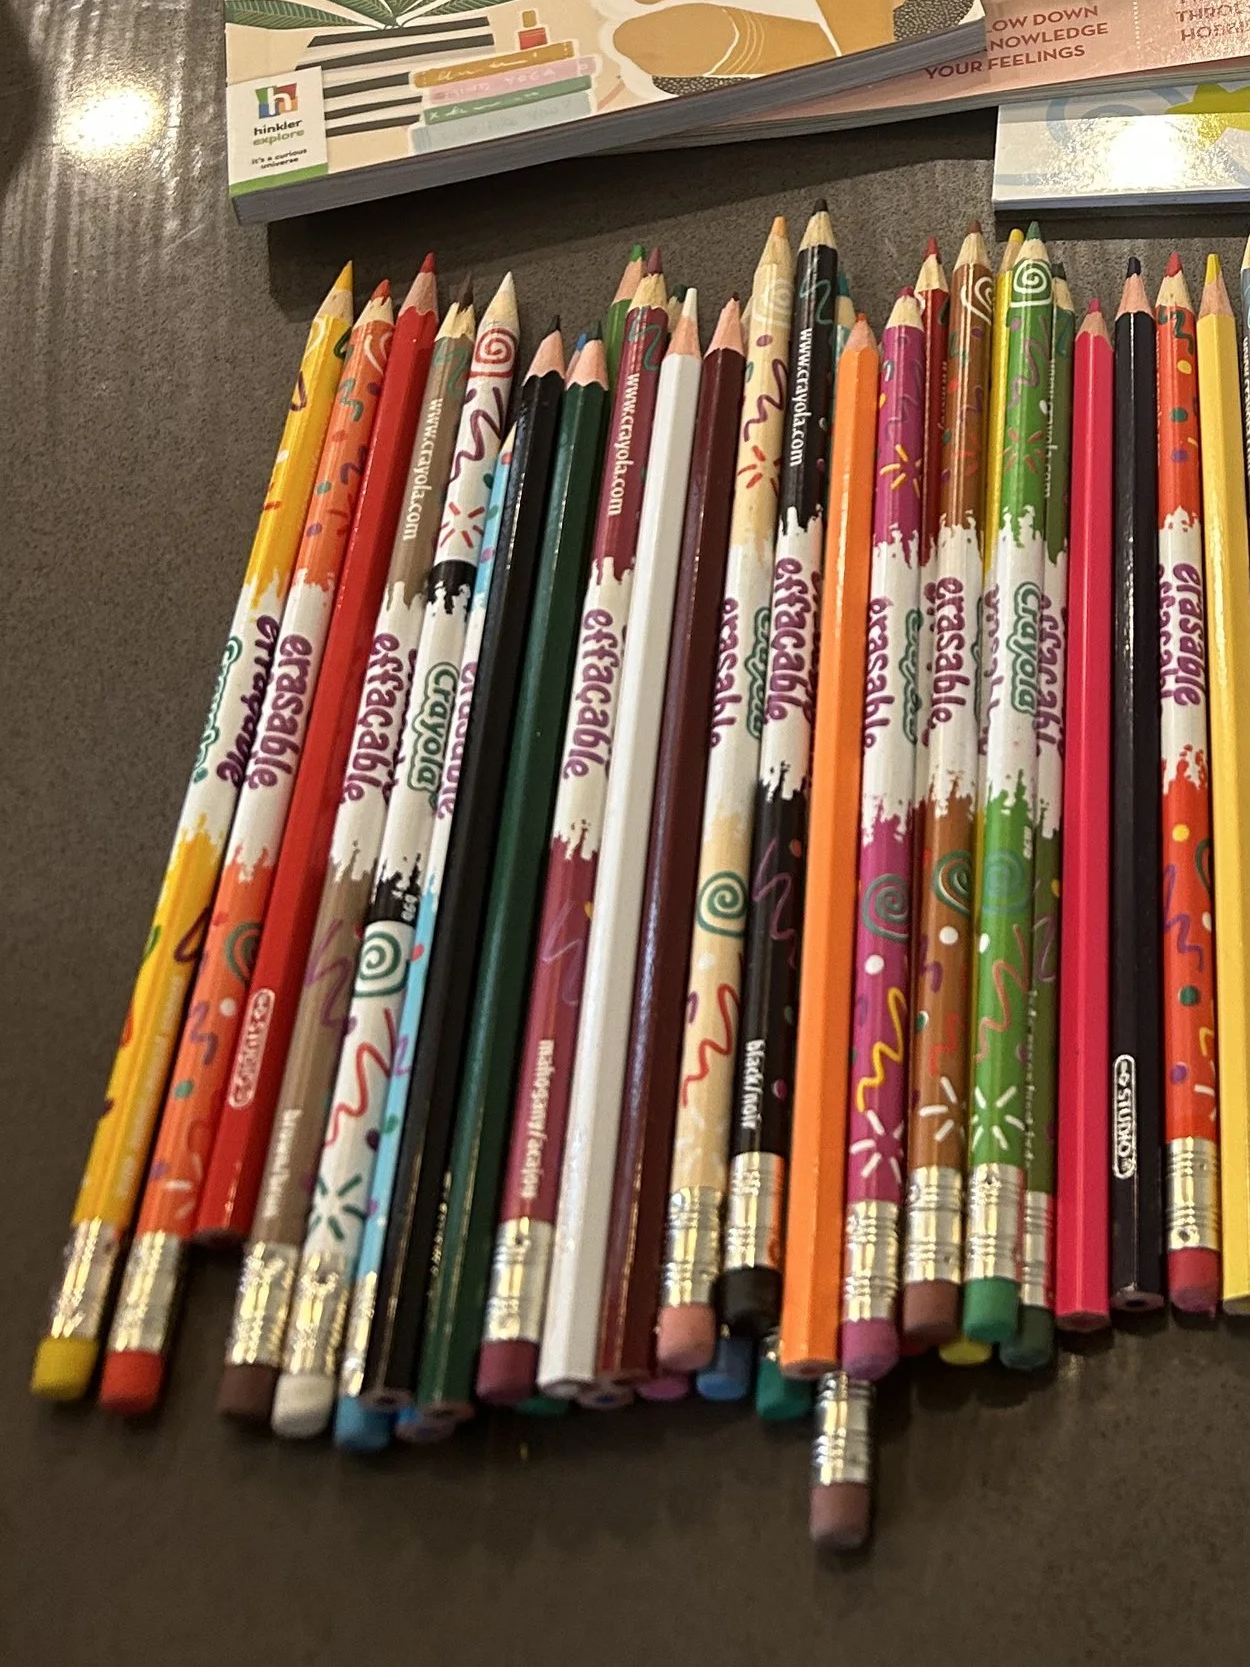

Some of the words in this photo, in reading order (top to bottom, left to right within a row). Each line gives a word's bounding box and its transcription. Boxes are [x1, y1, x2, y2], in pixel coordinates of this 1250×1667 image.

[924, 60, 983, 80] YOUR
[988, 44, 1086, 70] FEELINGS
[985, 22, 1109, 52] NOWLEDGE
[987, 15, 1028, 33] OW
[1033, 5, 1099, 26] DOWN
[252, 129, 305, 146] explore
[253, 119, 303, 136] hinkler
[260, 157, 299, 169] universe
[275, 148, 307, 160] curious
[608, 373, 641, 516] www.crayola.com
[790, 327, 813, 467] www.crayola.com
[402, 397, 444, 541] www.crayola.com
[930, 577, 971, 730] erasable
[1010, 584, 1041, 712] Crayola
[1173, 563, 1205, 706] erasable
[248, 633, 312, 791] erasable
[413, 666, 460, 788] Crayola
[562, 608, 620, 780] effaçable
[740, 1039, 765, 1131] black/noir
[1116, 1088, 1133, 1158] STUDIO
